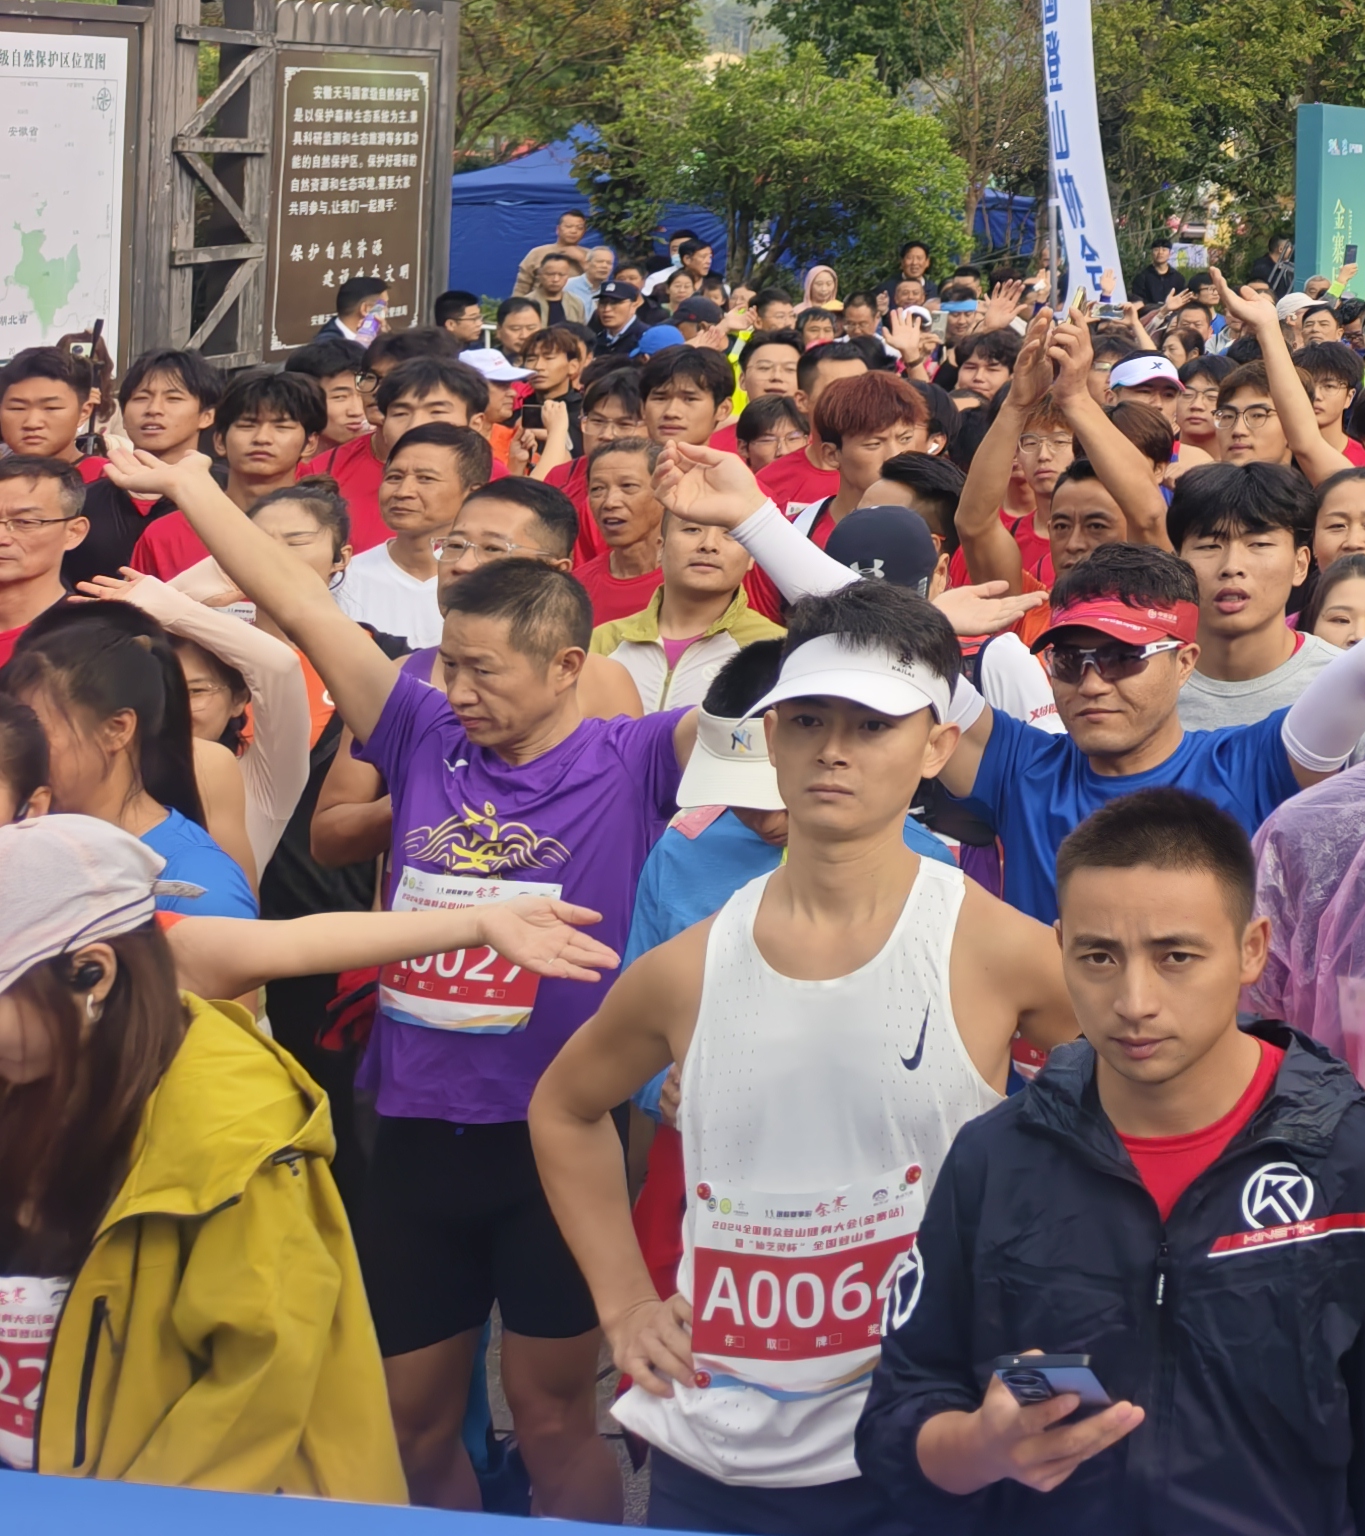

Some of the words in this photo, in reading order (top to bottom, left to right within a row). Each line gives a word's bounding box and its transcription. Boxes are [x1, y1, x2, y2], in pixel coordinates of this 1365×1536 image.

[290, 238, 383, 261] 保护自然资源
[815, 1196, 849, 1217] 金寨
[812, 1229, 876, 1252] 全国登山赛
